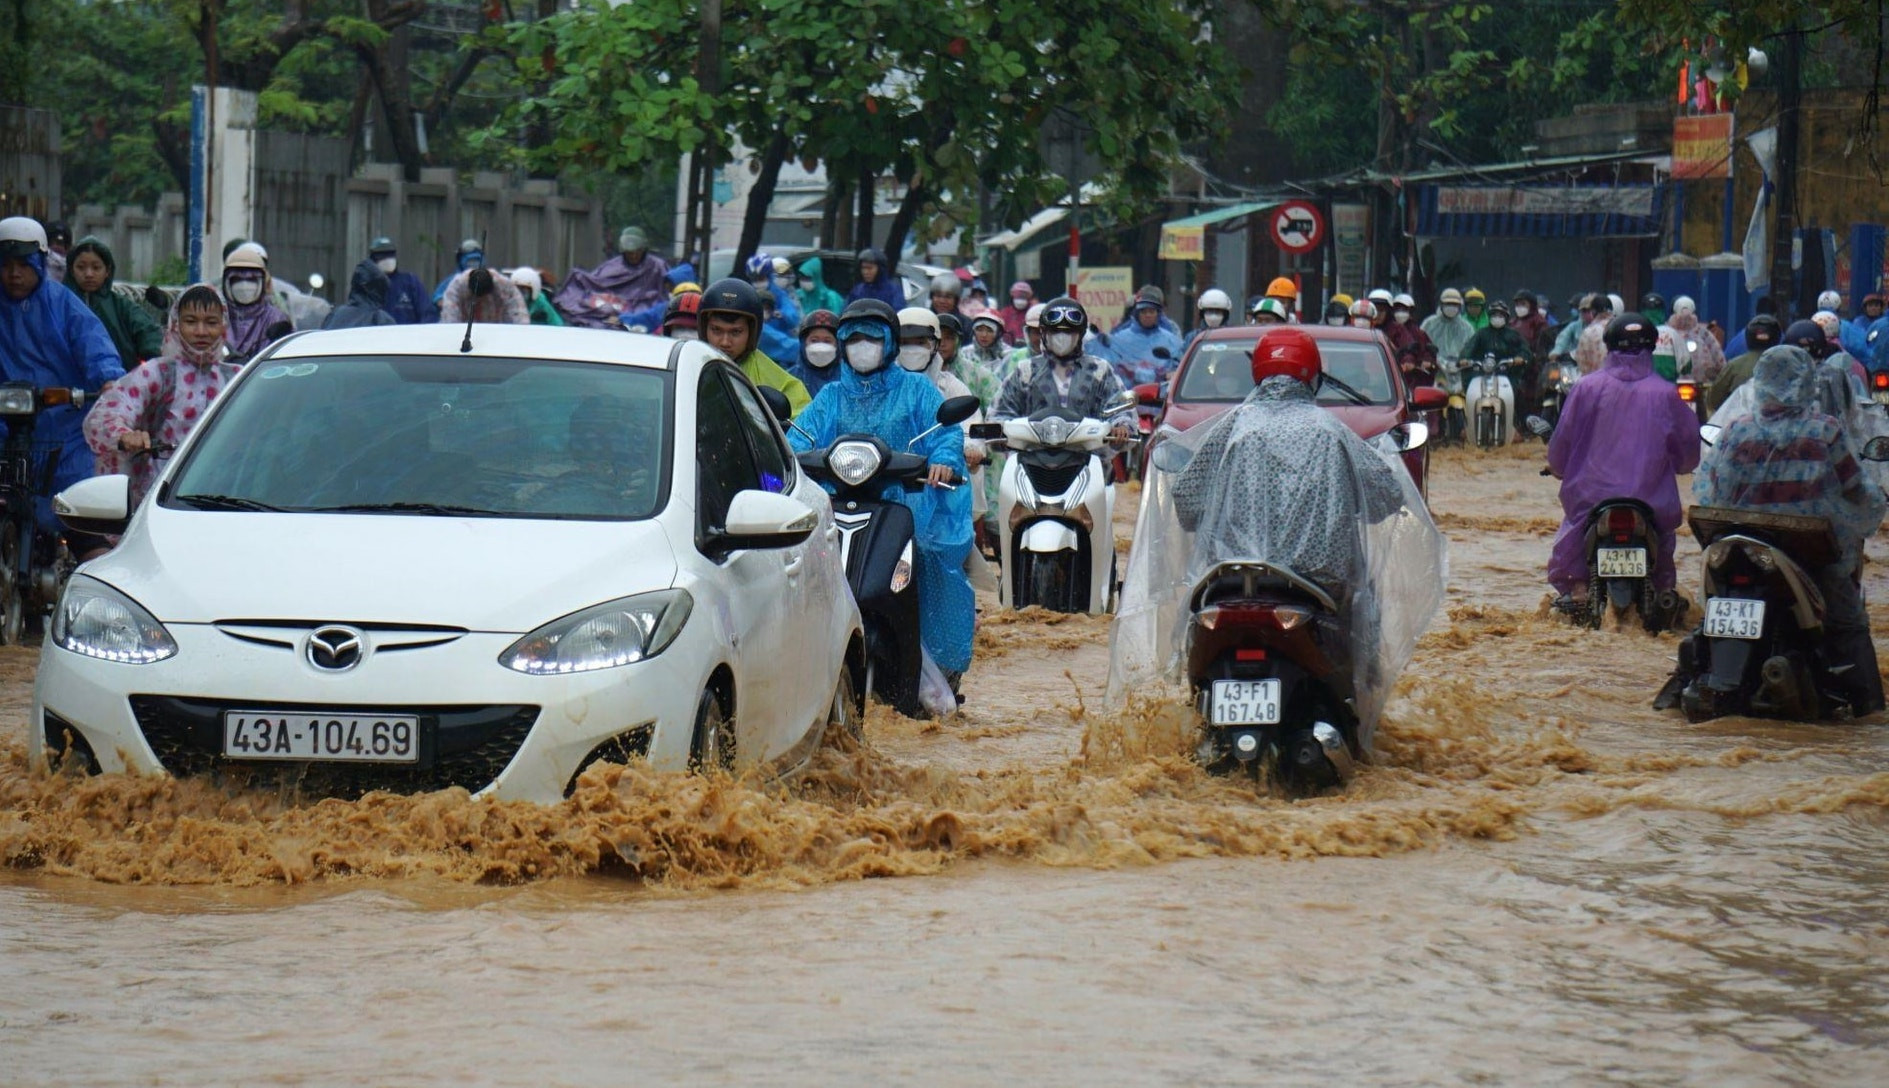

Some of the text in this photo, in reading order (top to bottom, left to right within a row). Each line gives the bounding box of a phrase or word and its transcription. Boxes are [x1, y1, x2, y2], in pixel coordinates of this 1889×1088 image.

[1077, 289, 1127, 307] ONDA
[1716, 601, 1755, 618] 43-K1
[1710, 618, 1758, 636] 154.36
[1223, 682, 1269, 701] 43-F1
[1218, 702, 1276, 722] 167.48
[232, 718, 411, 756] 43A-104.69
